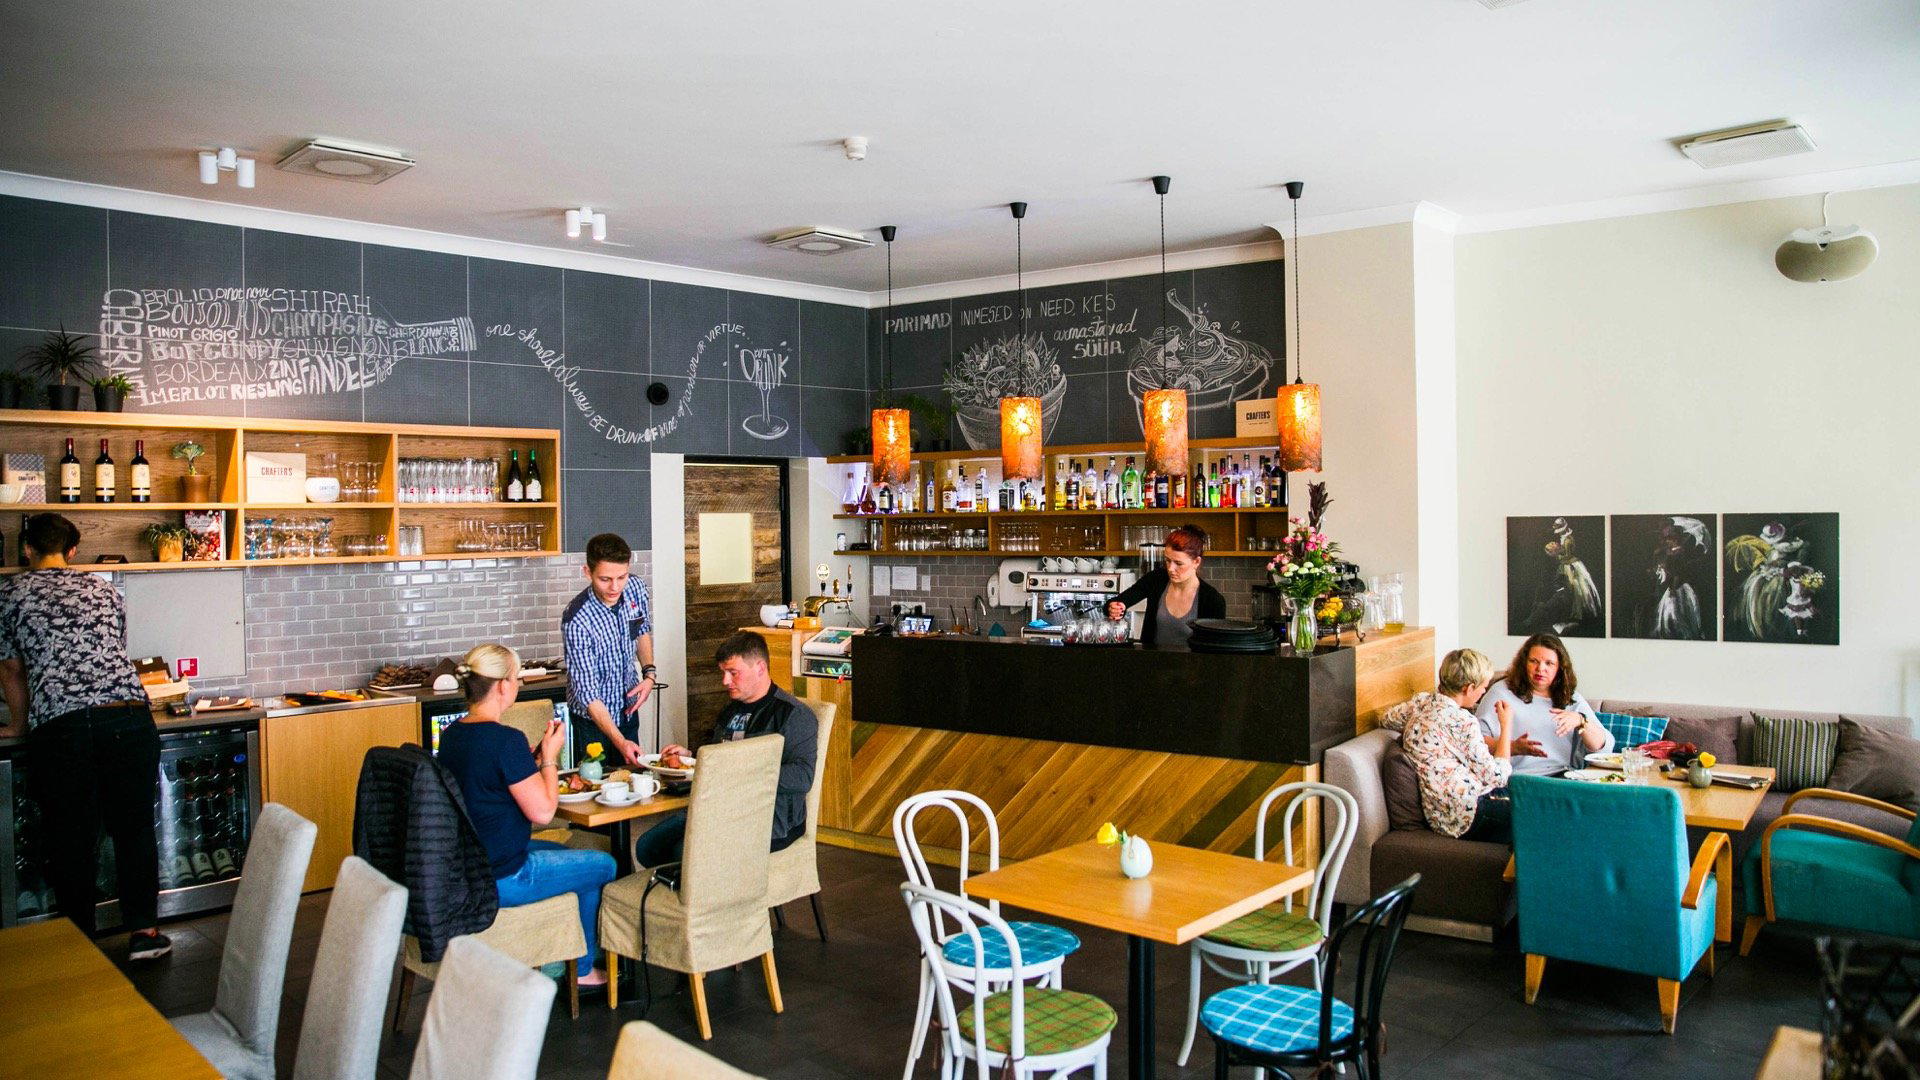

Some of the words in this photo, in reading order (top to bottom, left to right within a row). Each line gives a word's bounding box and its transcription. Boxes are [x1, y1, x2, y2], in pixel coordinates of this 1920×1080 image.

[271, 288, 371, 315] SHIRAH
[885, 312, 950, 335] PARIMAD
[960, 305, 1013, 326] INIMESED
[1082, 293, 1116, 313] KES
[147, 324, 189, 340] PINOT
[190, 328, 239, 342] GRIGIO
[282, 336, 392, 359] SAUVIGNON
[392, 336, 449, 361] BLANC
[153, 360, 268, 385] BORDEAUX
[485, 323, 516, 338] one
[589, 415, 608, 432] BE
[231, 379, 303, 400] RIESLING
